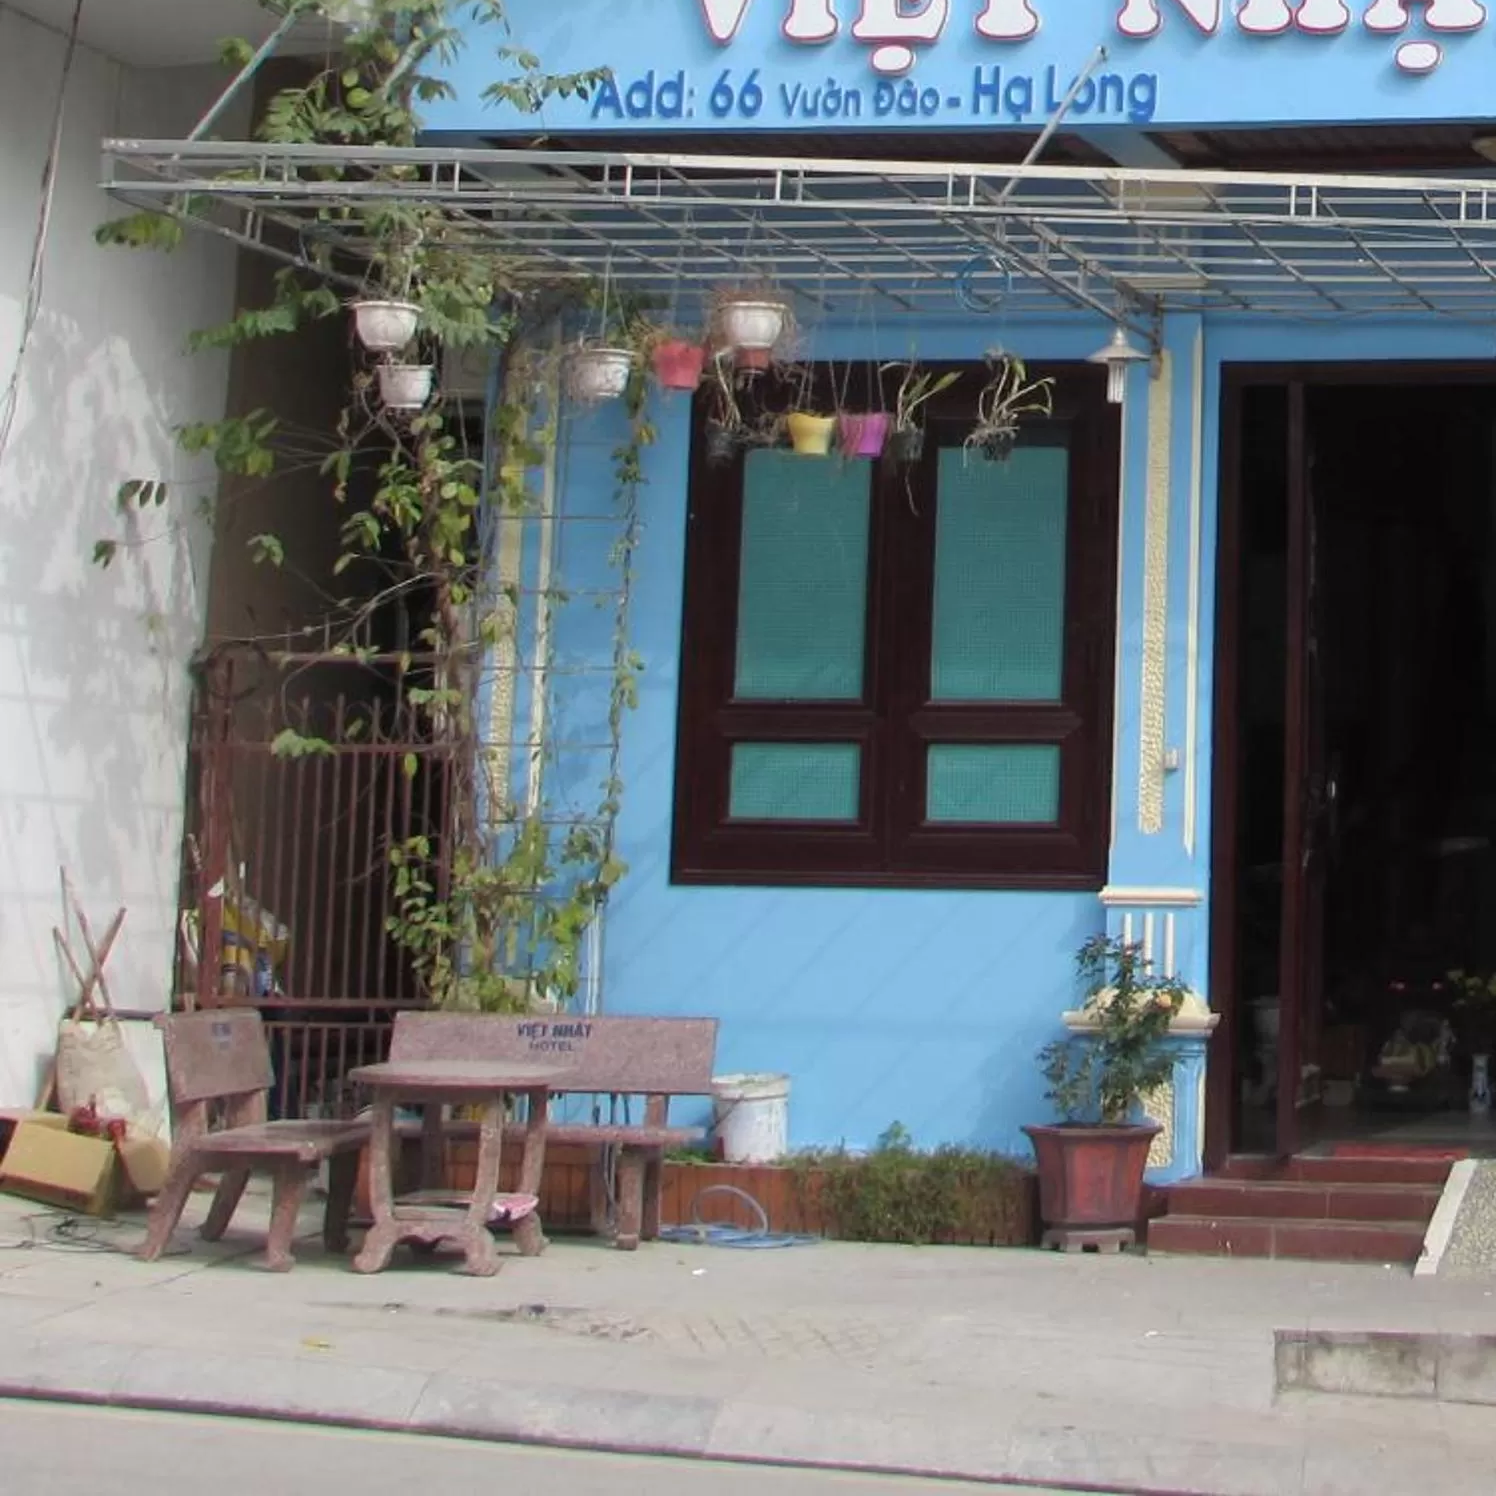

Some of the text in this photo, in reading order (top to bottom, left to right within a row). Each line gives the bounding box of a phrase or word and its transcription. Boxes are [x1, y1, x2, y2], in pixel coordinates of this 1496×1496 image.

[590, 68, 697, 119] Add:
[708, 68, 764, 118] 66
[1044, 64, 1158, 124] Long
